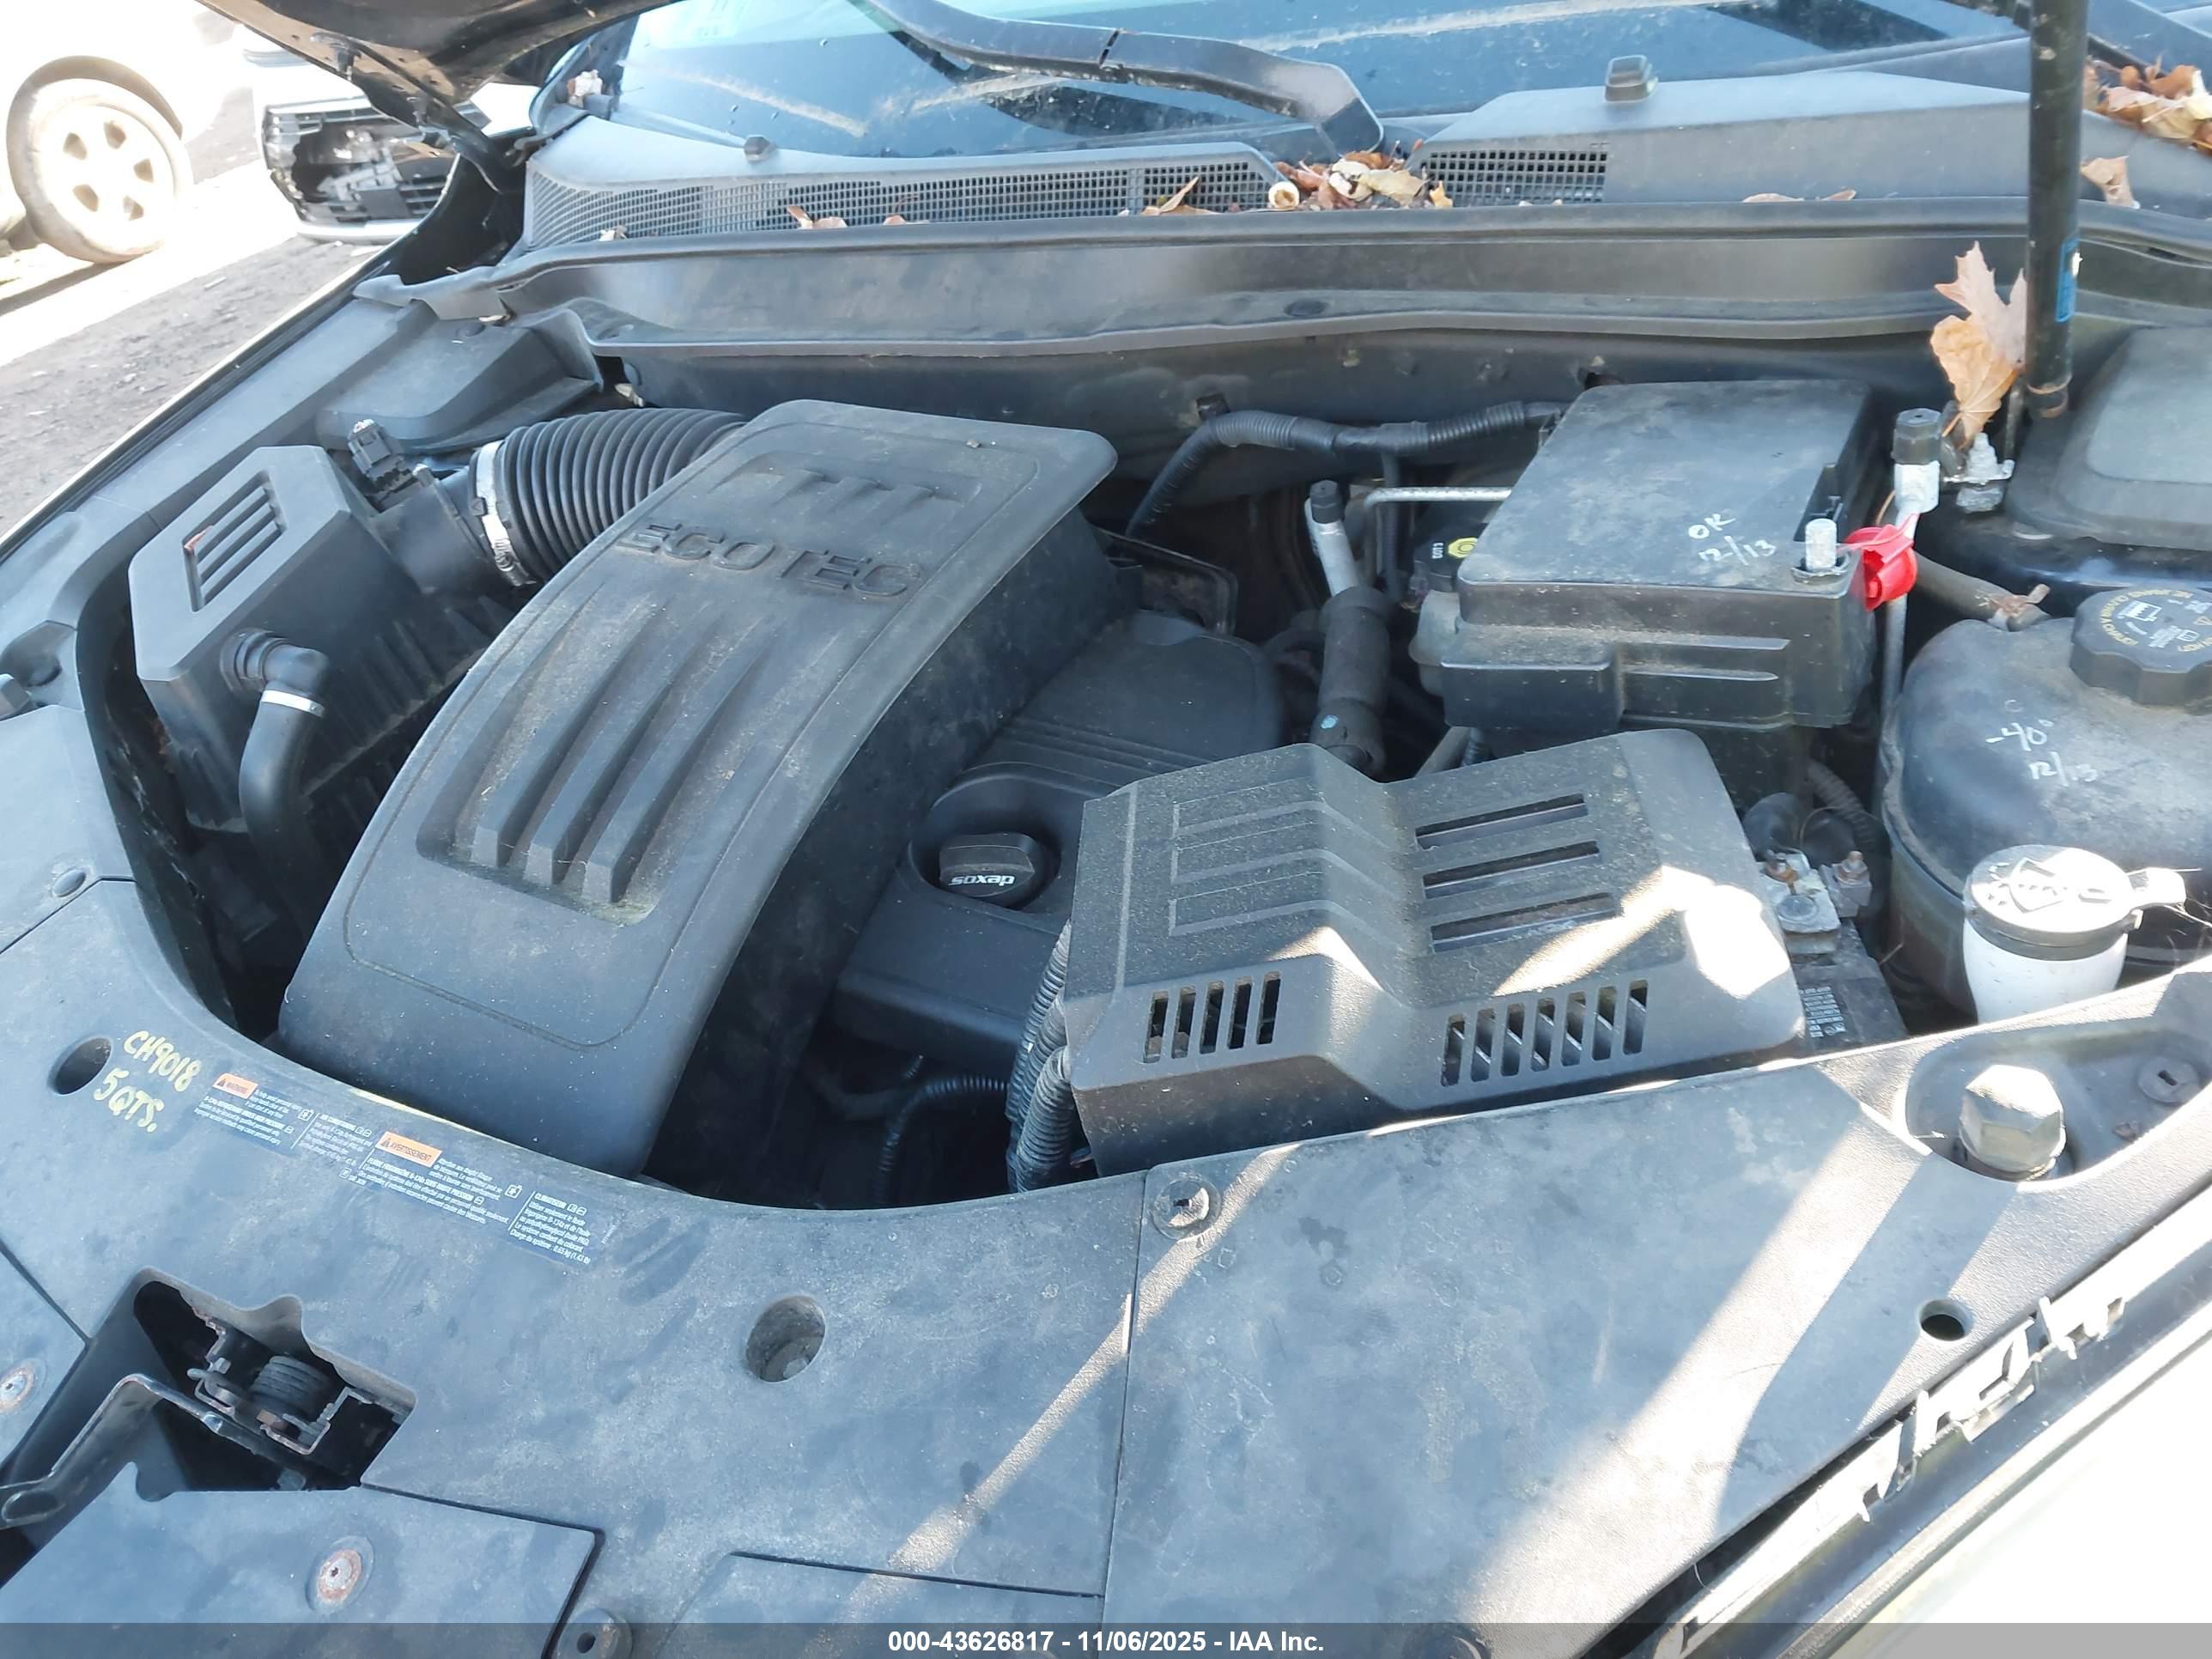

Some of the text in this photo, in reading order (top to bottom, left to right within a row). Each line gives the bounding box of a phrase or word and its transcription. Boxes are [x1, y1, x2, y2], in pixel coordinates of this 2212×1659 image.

[1688, 514, 1735, 539] OK
[616, 522, 922, 598] ECOTEC
[948, 874, 1015, 886] dexos
[124, 1030, 202, 1091] CH9018
[94, 1068, 129, 1101] 5
